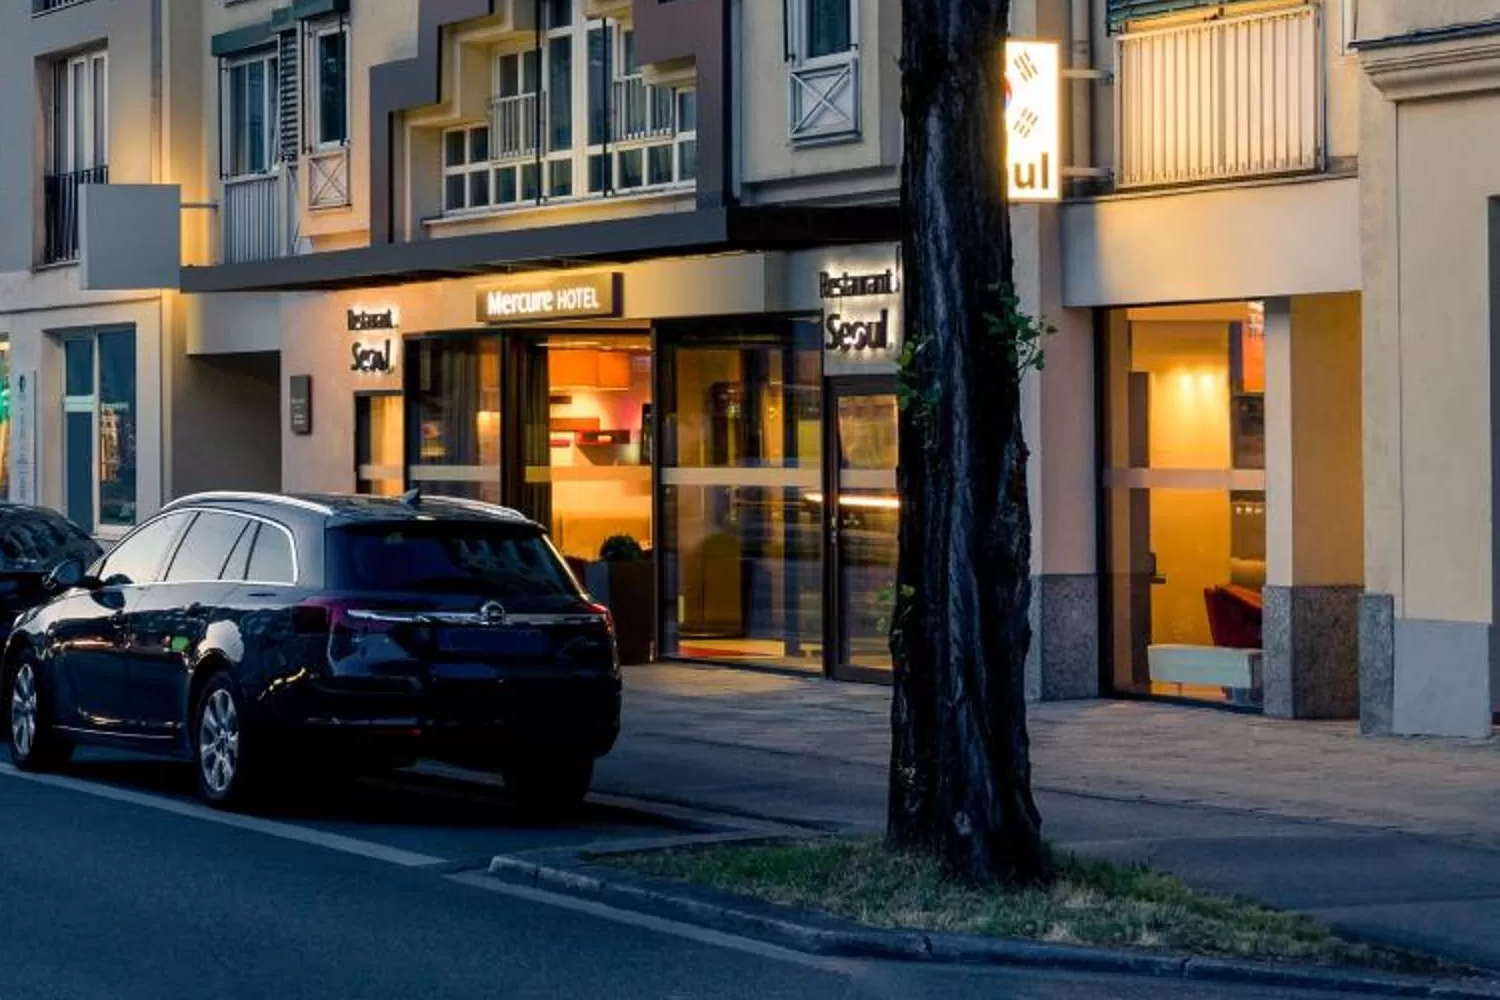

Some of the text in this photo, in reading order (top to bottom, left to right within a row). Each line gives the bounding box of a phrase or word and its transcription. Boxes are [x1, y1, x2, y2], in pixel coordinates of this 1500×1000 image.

[819, 269, 892, 298] Restaurant
[488, 287, 598, 315] Mercure HOTEL
[825, 309, 888, 351] Seoul
[352, 339, 390, 371] Seoul
